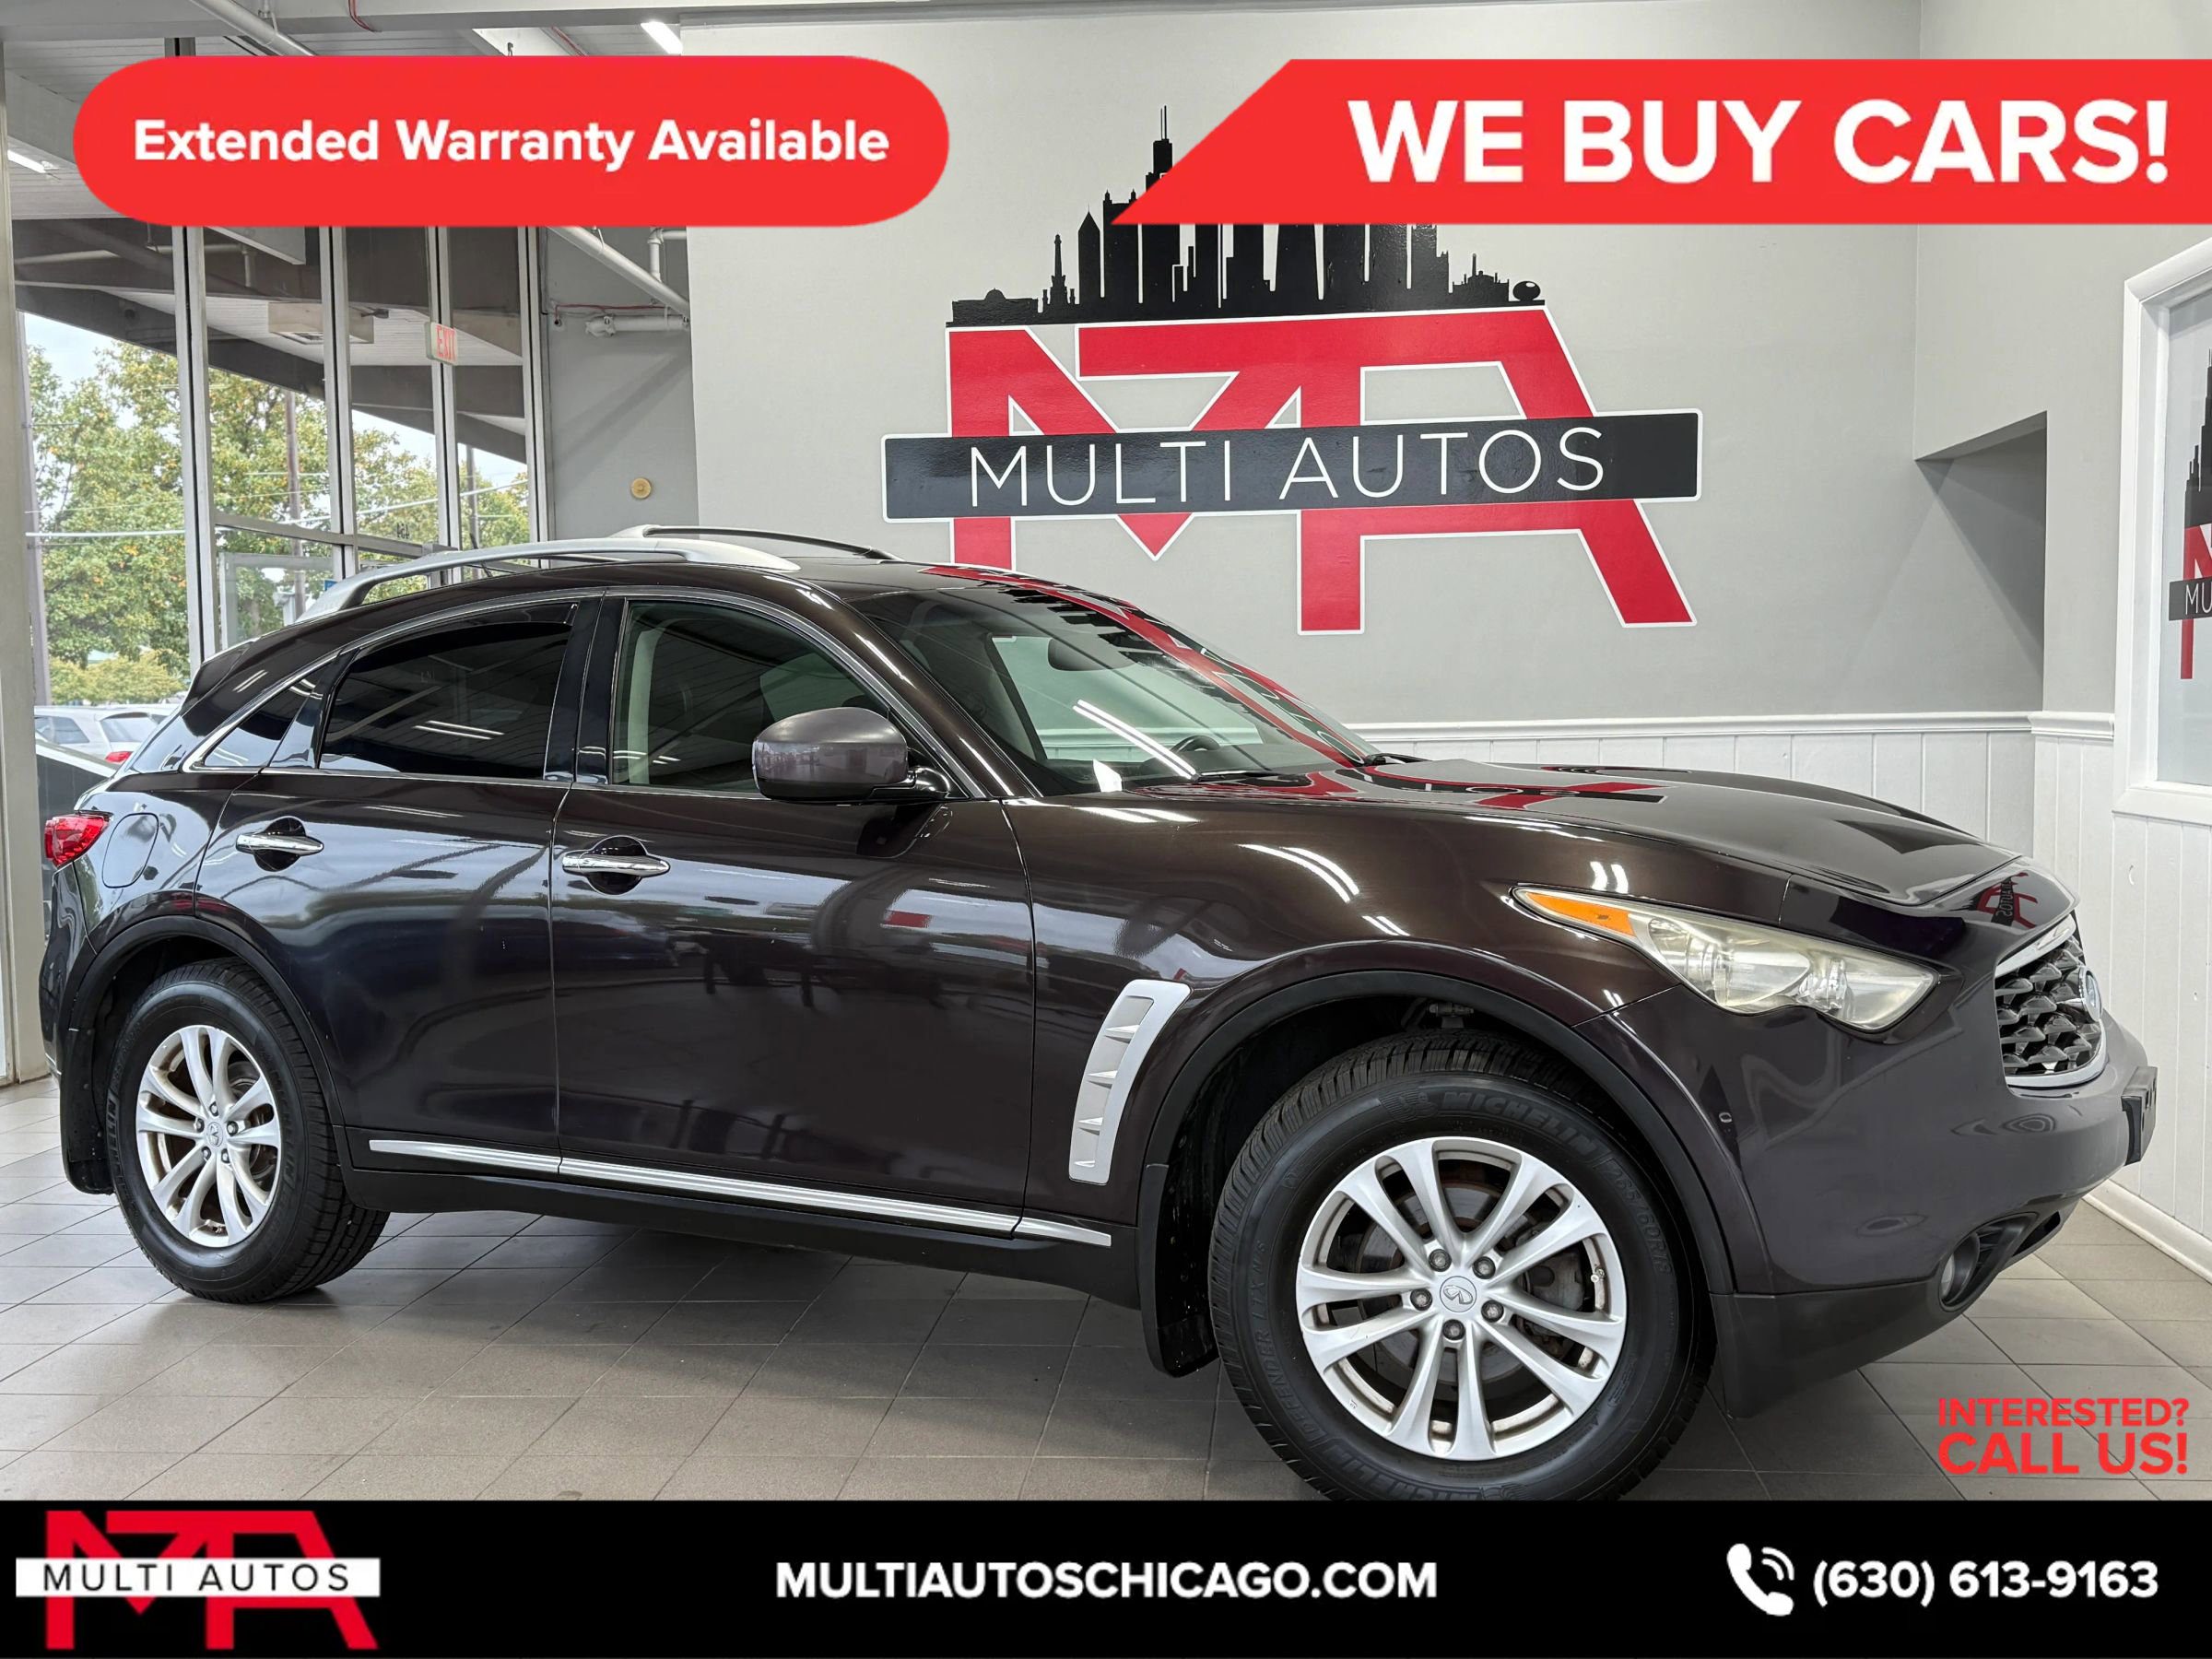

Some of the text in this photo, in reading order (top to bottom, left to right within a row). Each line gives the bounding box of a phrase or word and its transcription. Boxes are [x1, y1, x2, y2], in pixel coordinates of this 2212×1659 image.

[436, 324, 457, 362] EXIT
[971, 428, 1605, 507] MULTI AUTOS
[1442, 1090, 1598, 1158] MICHELIN
[1254, 1331, 1327, 1444] DEFENDER
